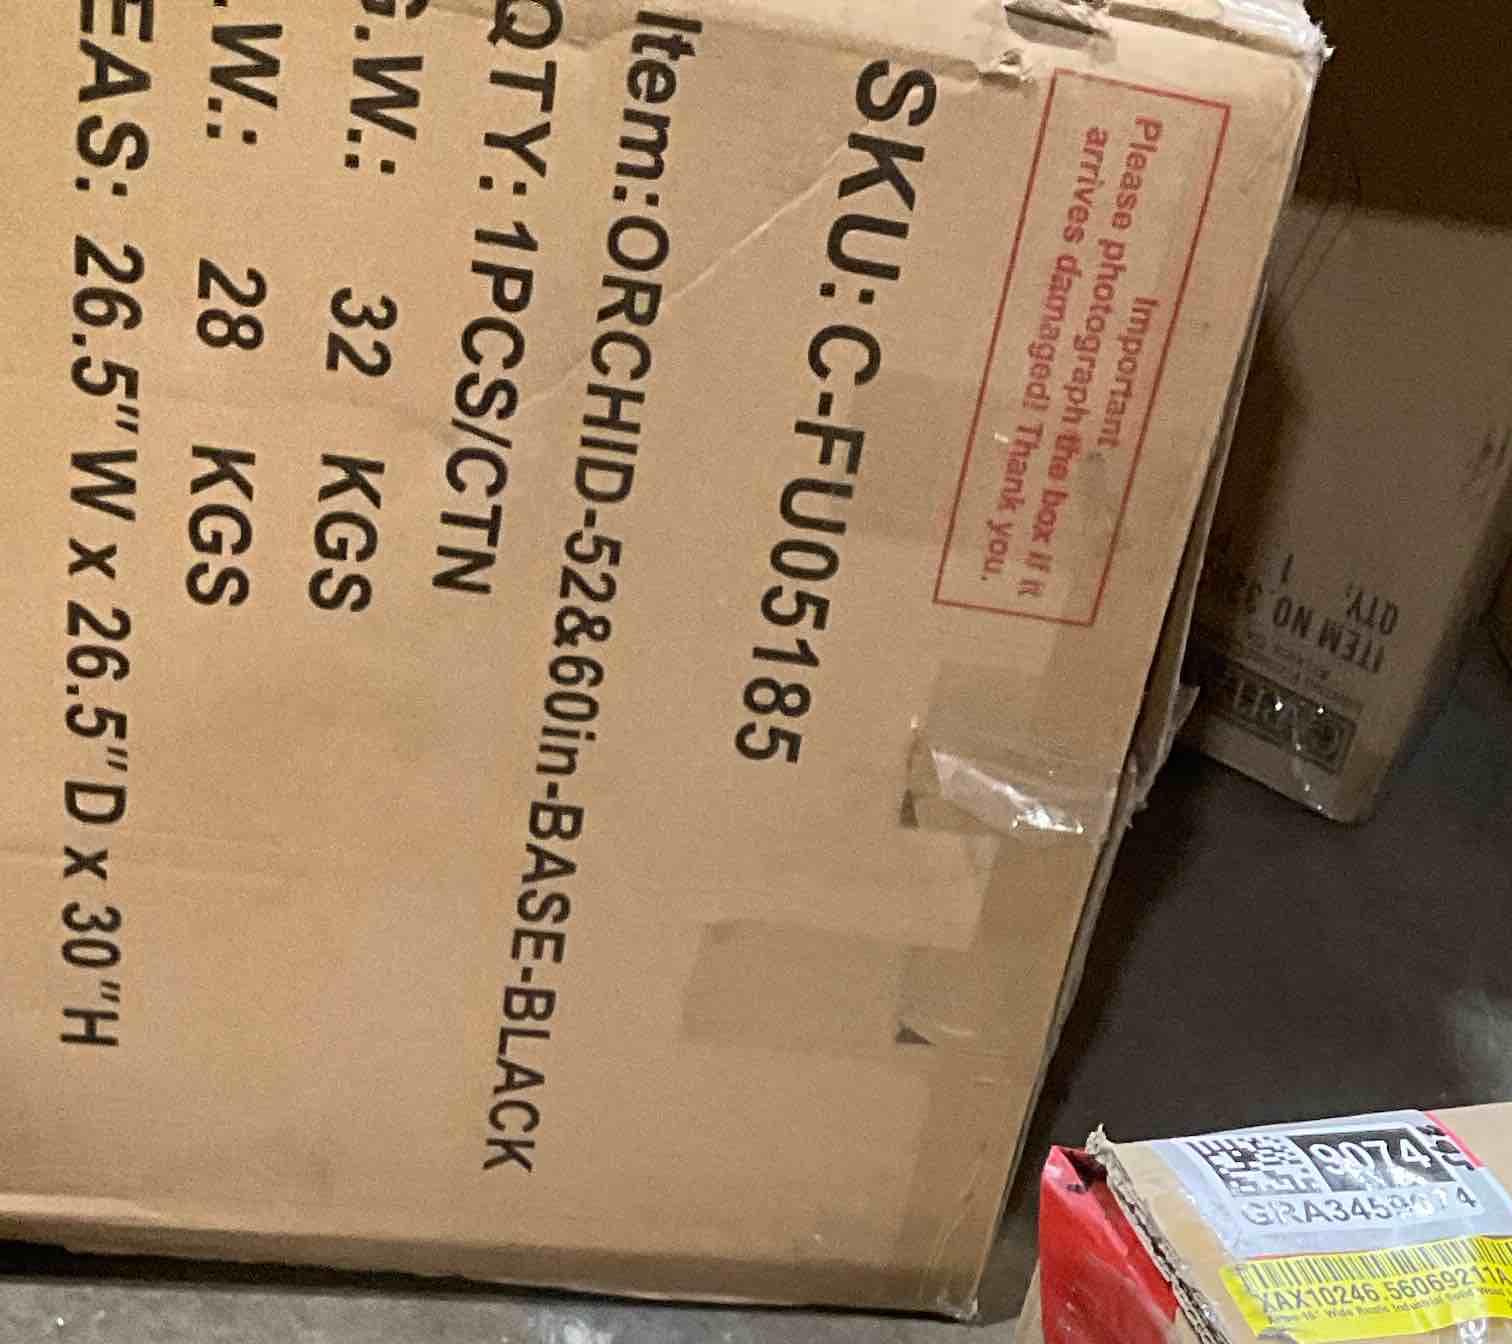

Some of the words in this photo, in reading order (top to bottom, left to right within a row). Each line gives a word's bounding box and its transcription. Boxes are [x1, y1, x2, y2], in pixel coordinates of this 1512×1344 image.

[478, 0, 566, 198] QTY:
[1063, 125, 1110, 245] arrives
[1111, 114, 1164, 232] Please
[195, 255, 268, 354] 28
[325, 284, 400, 379] 32
[1060, 236, 1130, 432] photograph
[1096, 295, 1160, 450] Important
[997, 419, 1045, 515] Thank
[1047, 430, 1083, 484] the
[68, 537, 119, 581] x
[184, 442, 257, 609] KGS
[307, 451, 387, 614] KGS
[979, 518, 1014, 584] you.
[1024, 546, 1052, 576] if
[1029, 482, 1072, 548] box
[1016, 576, 1044, 600] it
[63, 845, 111, 882] x
